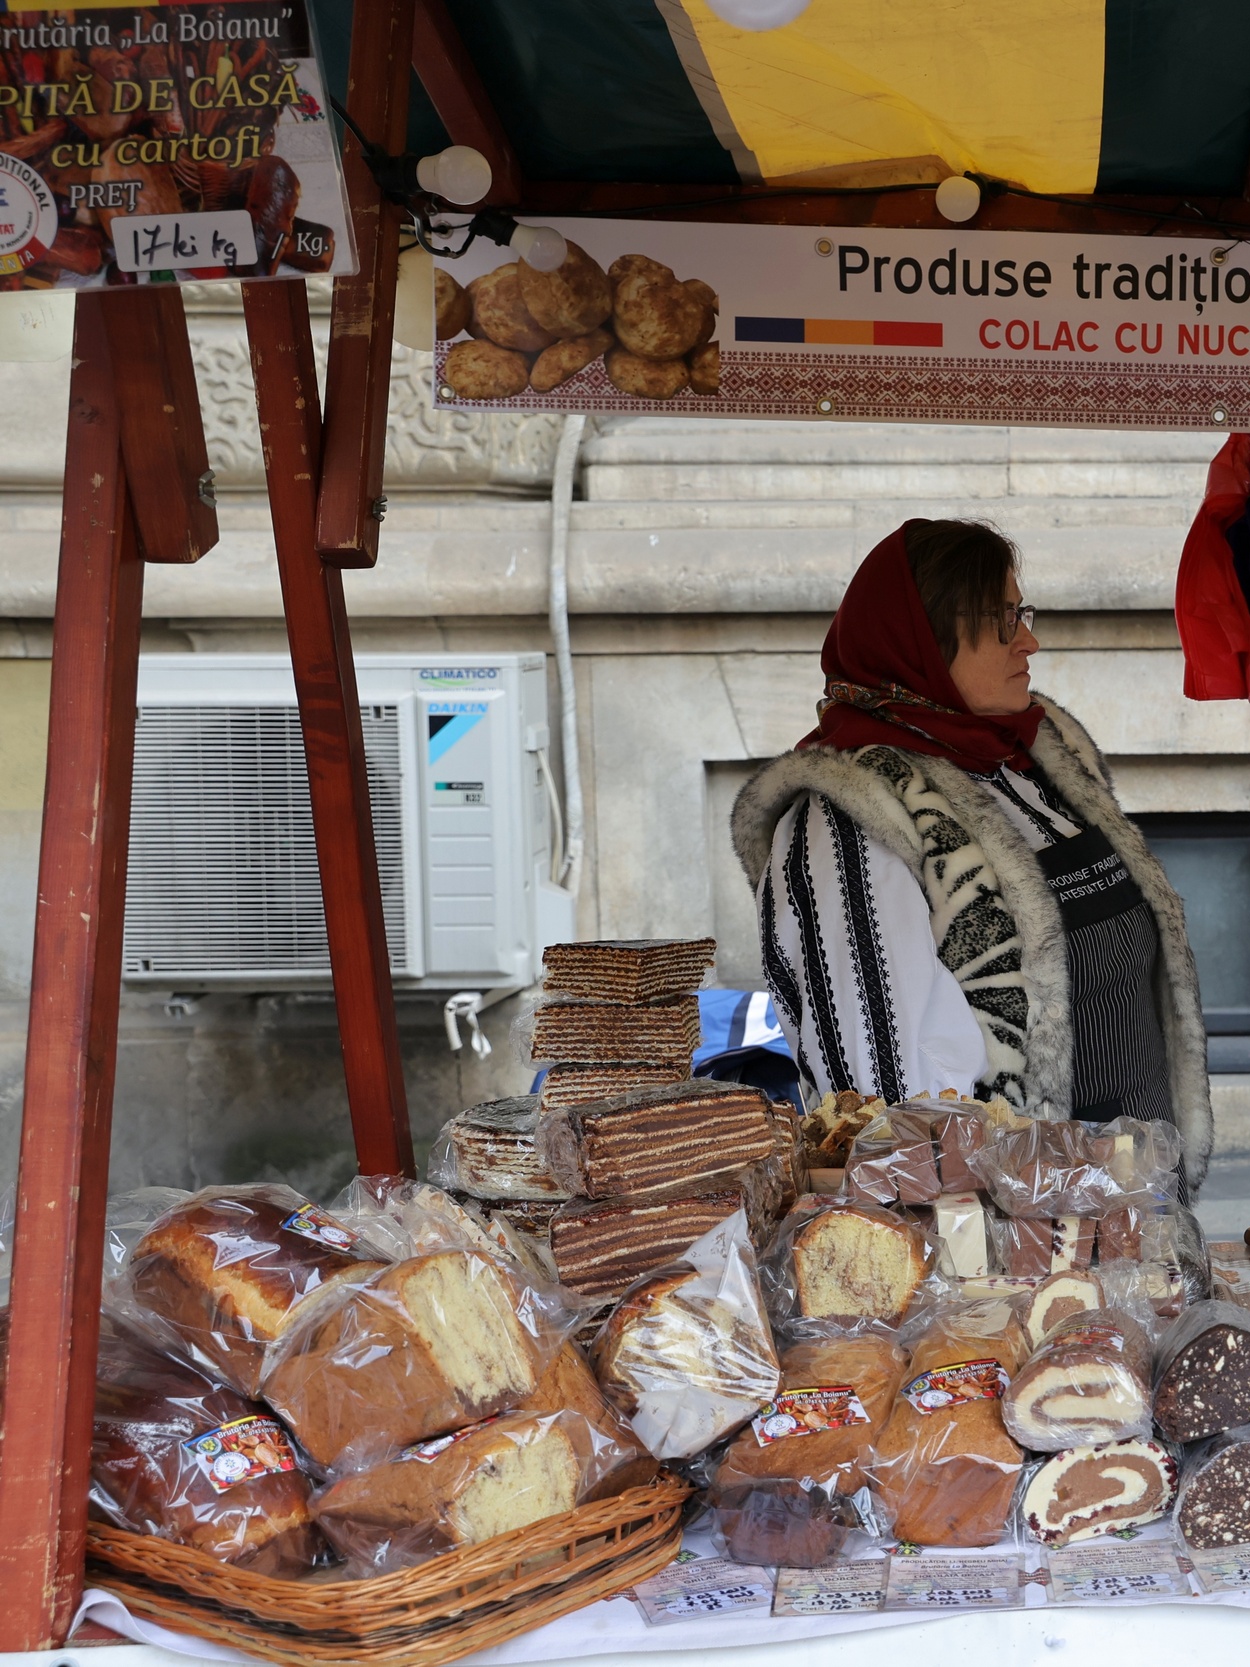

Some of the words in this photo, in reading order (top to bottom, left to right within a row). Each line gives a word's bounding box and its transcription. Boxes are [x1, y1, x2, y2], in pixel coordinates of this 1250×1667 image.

[0, 19, 111, 49] rutăria
[113, 79, 174, 113] DE
[188, 65, 301, 109] CASĂ
[52, 143, 103, 168] cu
[117, 126, 262, 168] cartofi
[838, 245, 1052, 298] Produse
[979, 318, 1100, 353] COLAC
[1114, 322, 1163, 354] CU
[420, 669, 497, 680] CLIMATICO
[428, 703, 489, 714] DAIKIN
[1047, 867, 1091, 889] RODUSE
[1059, 879, 1107, 903] ATESTATE
